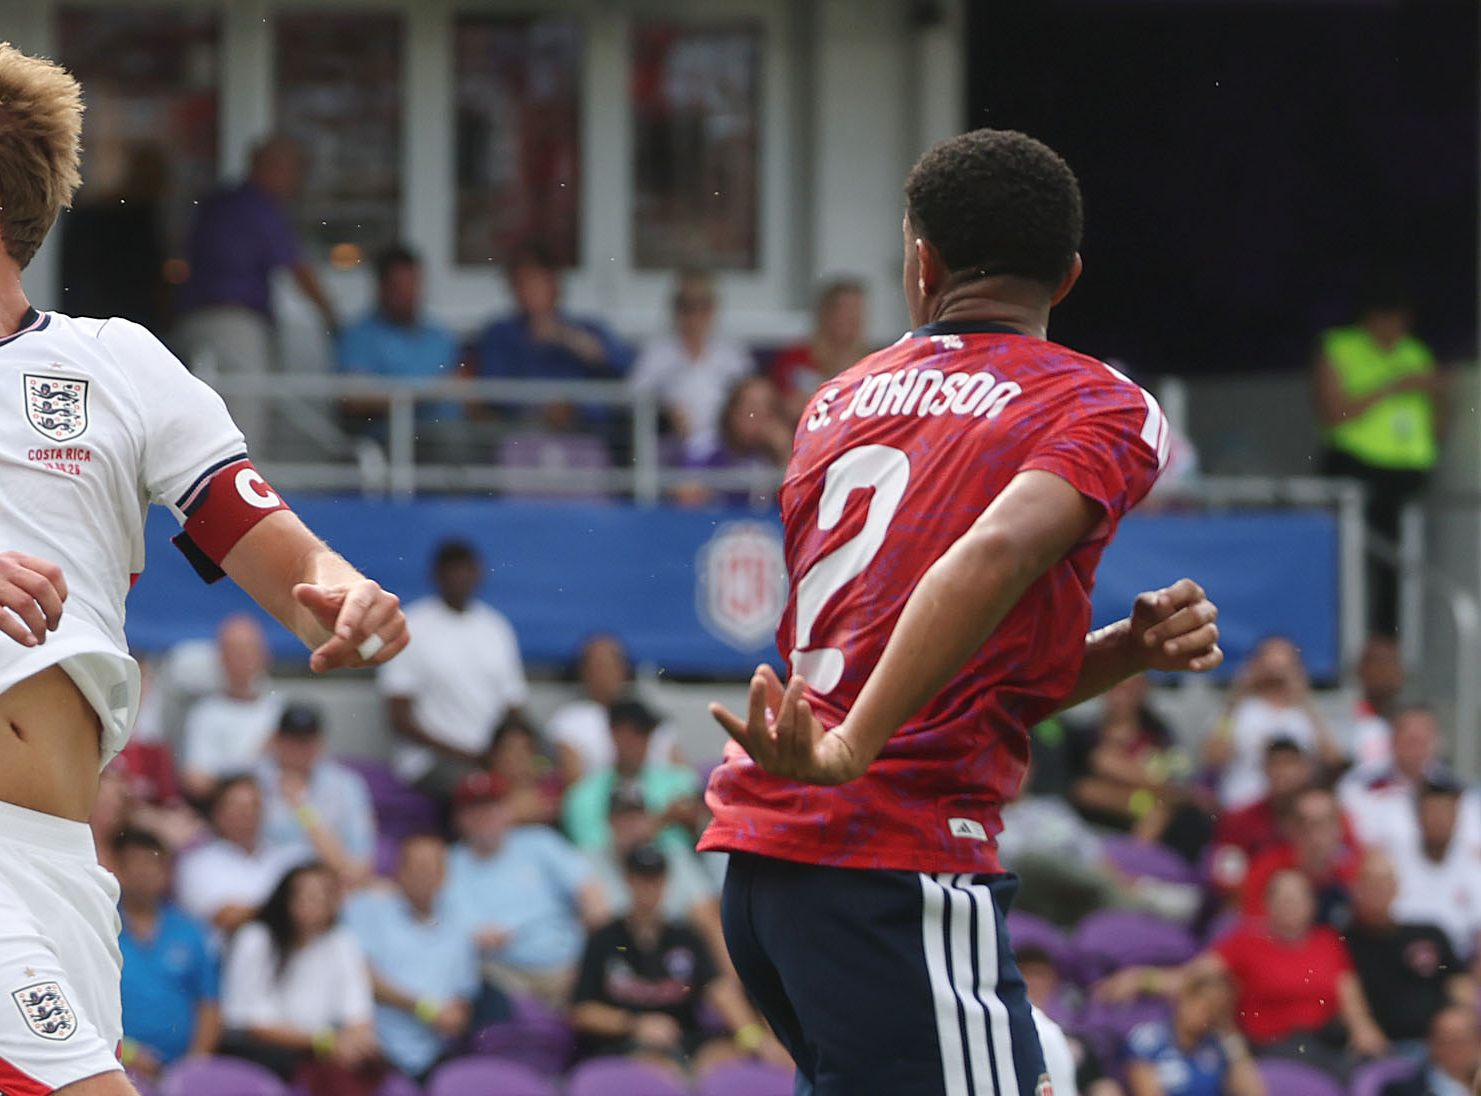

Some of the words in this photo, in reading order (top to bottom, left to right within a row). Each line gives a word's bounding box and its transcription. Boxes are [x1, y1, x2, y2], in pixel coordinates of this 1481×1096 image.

[807, 388, 839, 431] S.
[839, 367, 1024, 421] JOHNSON
[28, 448, 63, 462] COSTA
[65, 447, 91, 463] RICA
[234, 467, 282, 509] C
[788, 443, 911, 695] 2
